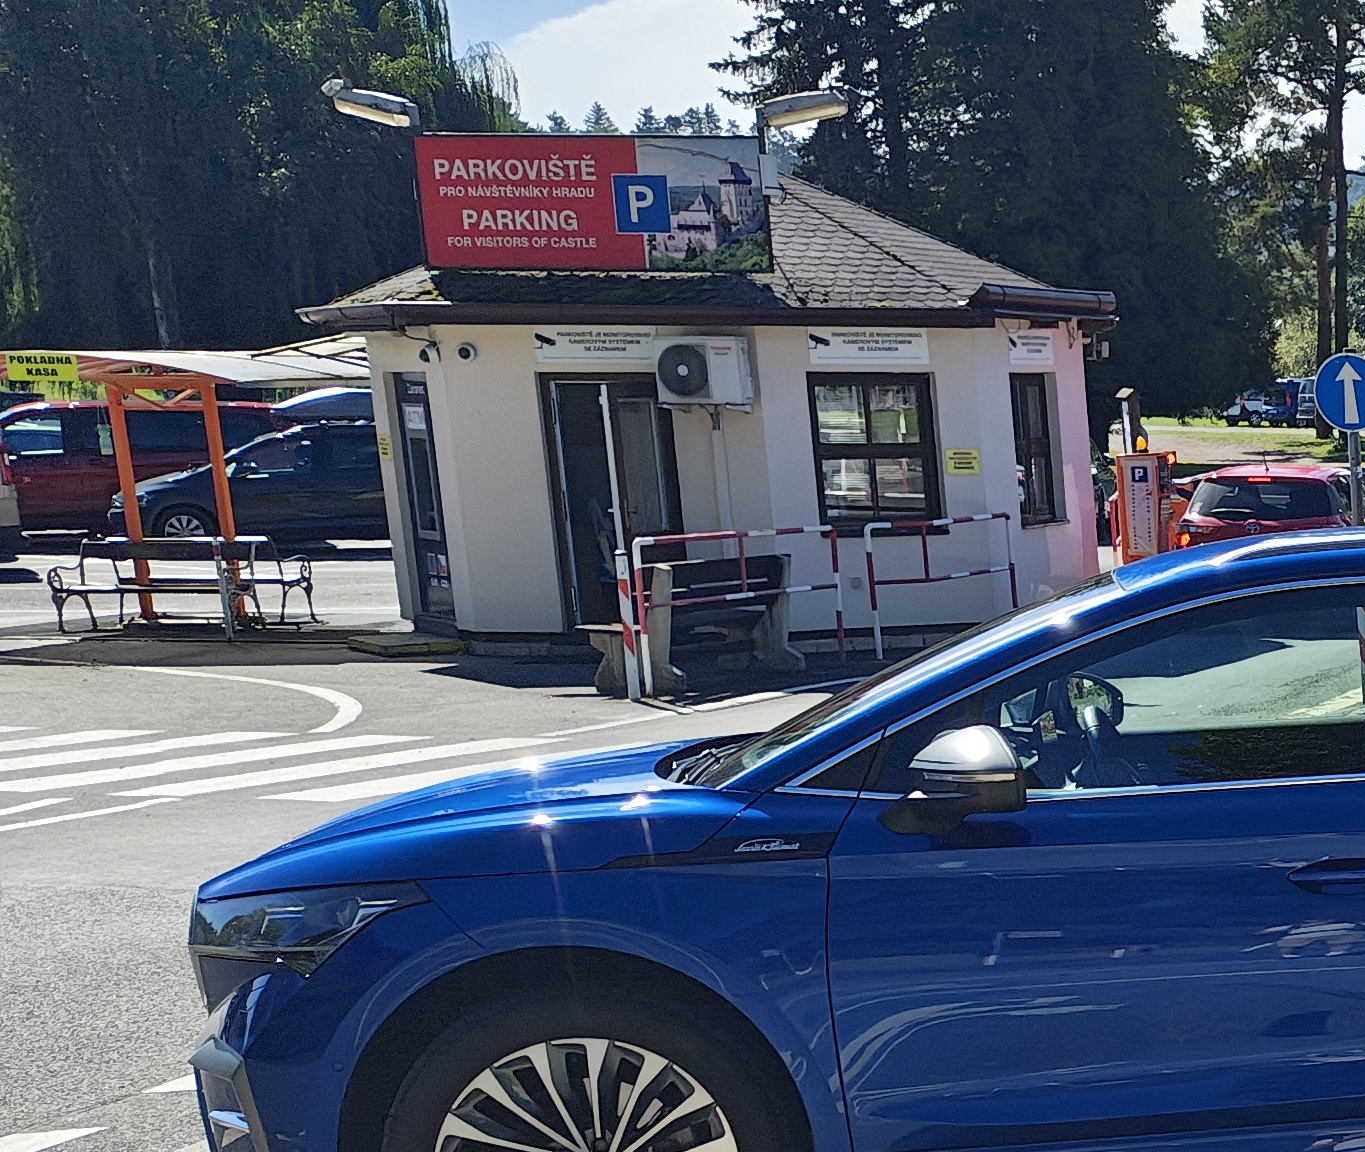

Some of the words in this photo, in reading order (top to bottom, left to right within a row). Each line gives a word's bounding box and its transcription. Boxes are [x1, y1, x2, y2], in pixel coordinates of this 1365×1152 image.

[433, 153, 598, 182] PARKOVIŠTĚ
[439, 186, 465, 198] PRO
[467, 184, 550, 198] NÁVŠTĚVNÍKY
[552, 186, 596, 198] HRADU
[627, 185, 654, 223] P
[462, 209, 579, 231] PARKING
[447, 236, 472, 248] FOR
[474, 236, 530, 248] VISITORS
[532, 236, 549, 248] OF
[550, 236, 597, 249] CASTLE
[8, 355, 73, 365] POKLADNA
[26, 367, 59, 377] KASA
[1134, 468, 1144, 481] P
